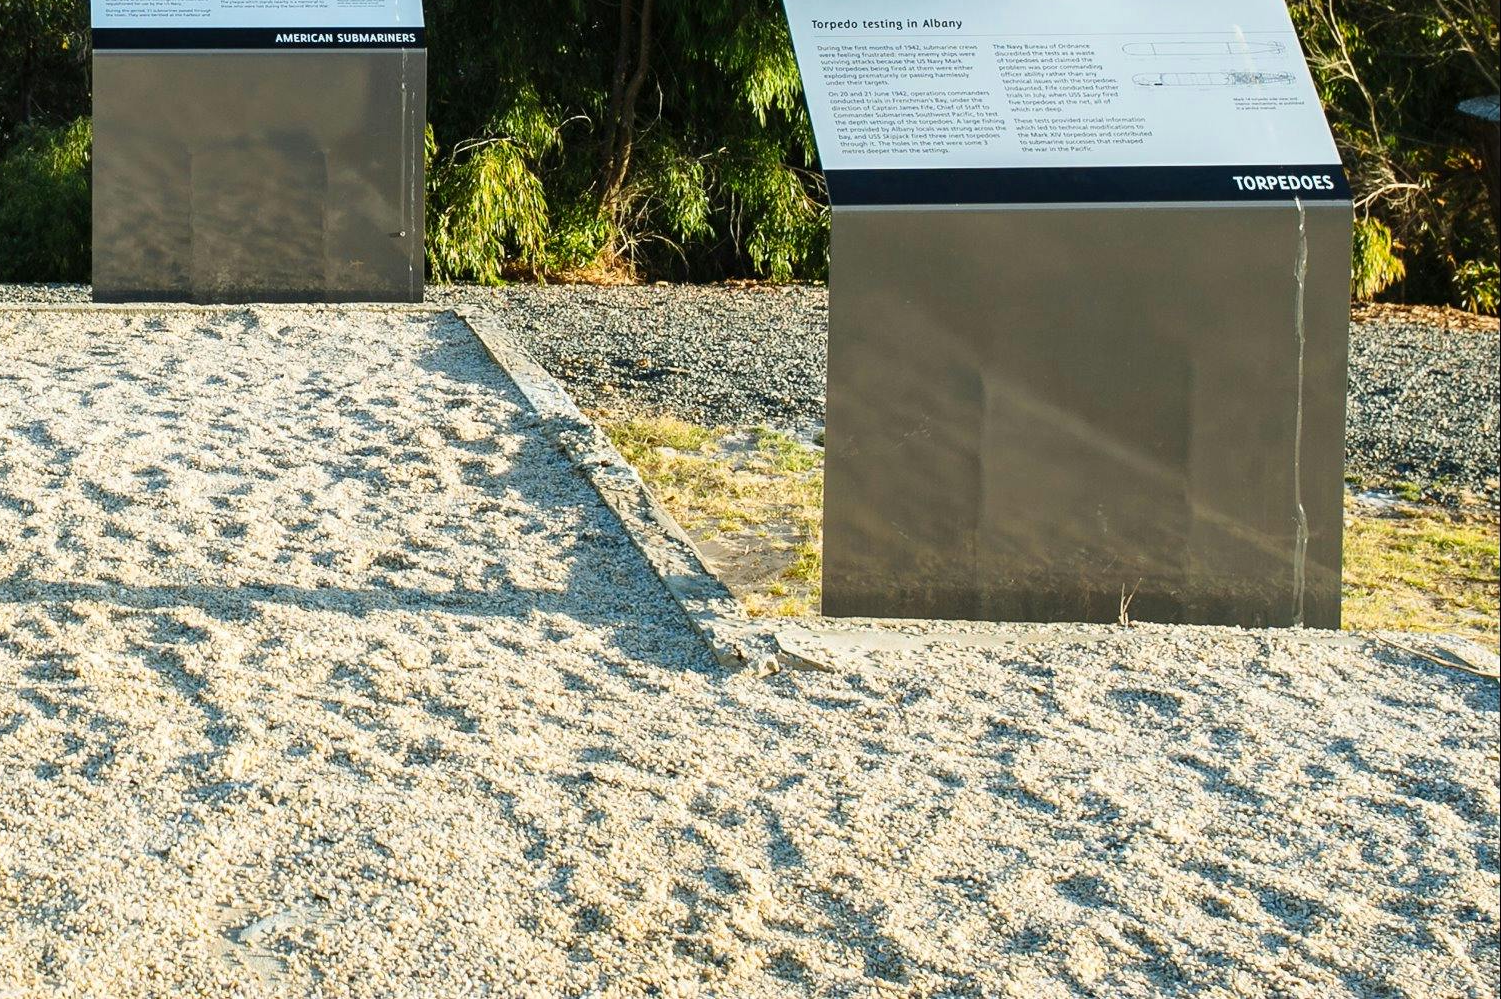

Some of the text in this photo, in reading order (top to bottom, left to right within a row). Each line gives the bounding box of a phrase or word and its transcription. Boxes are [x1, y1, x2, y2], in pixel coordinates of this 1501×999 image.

[812, 19, 962, 30] Torpedo testing in Albany
[276, 33, 416, 42] AMERICAN SUBMARINERS
[1233, 175, 1334, 190] TORPEDOES
